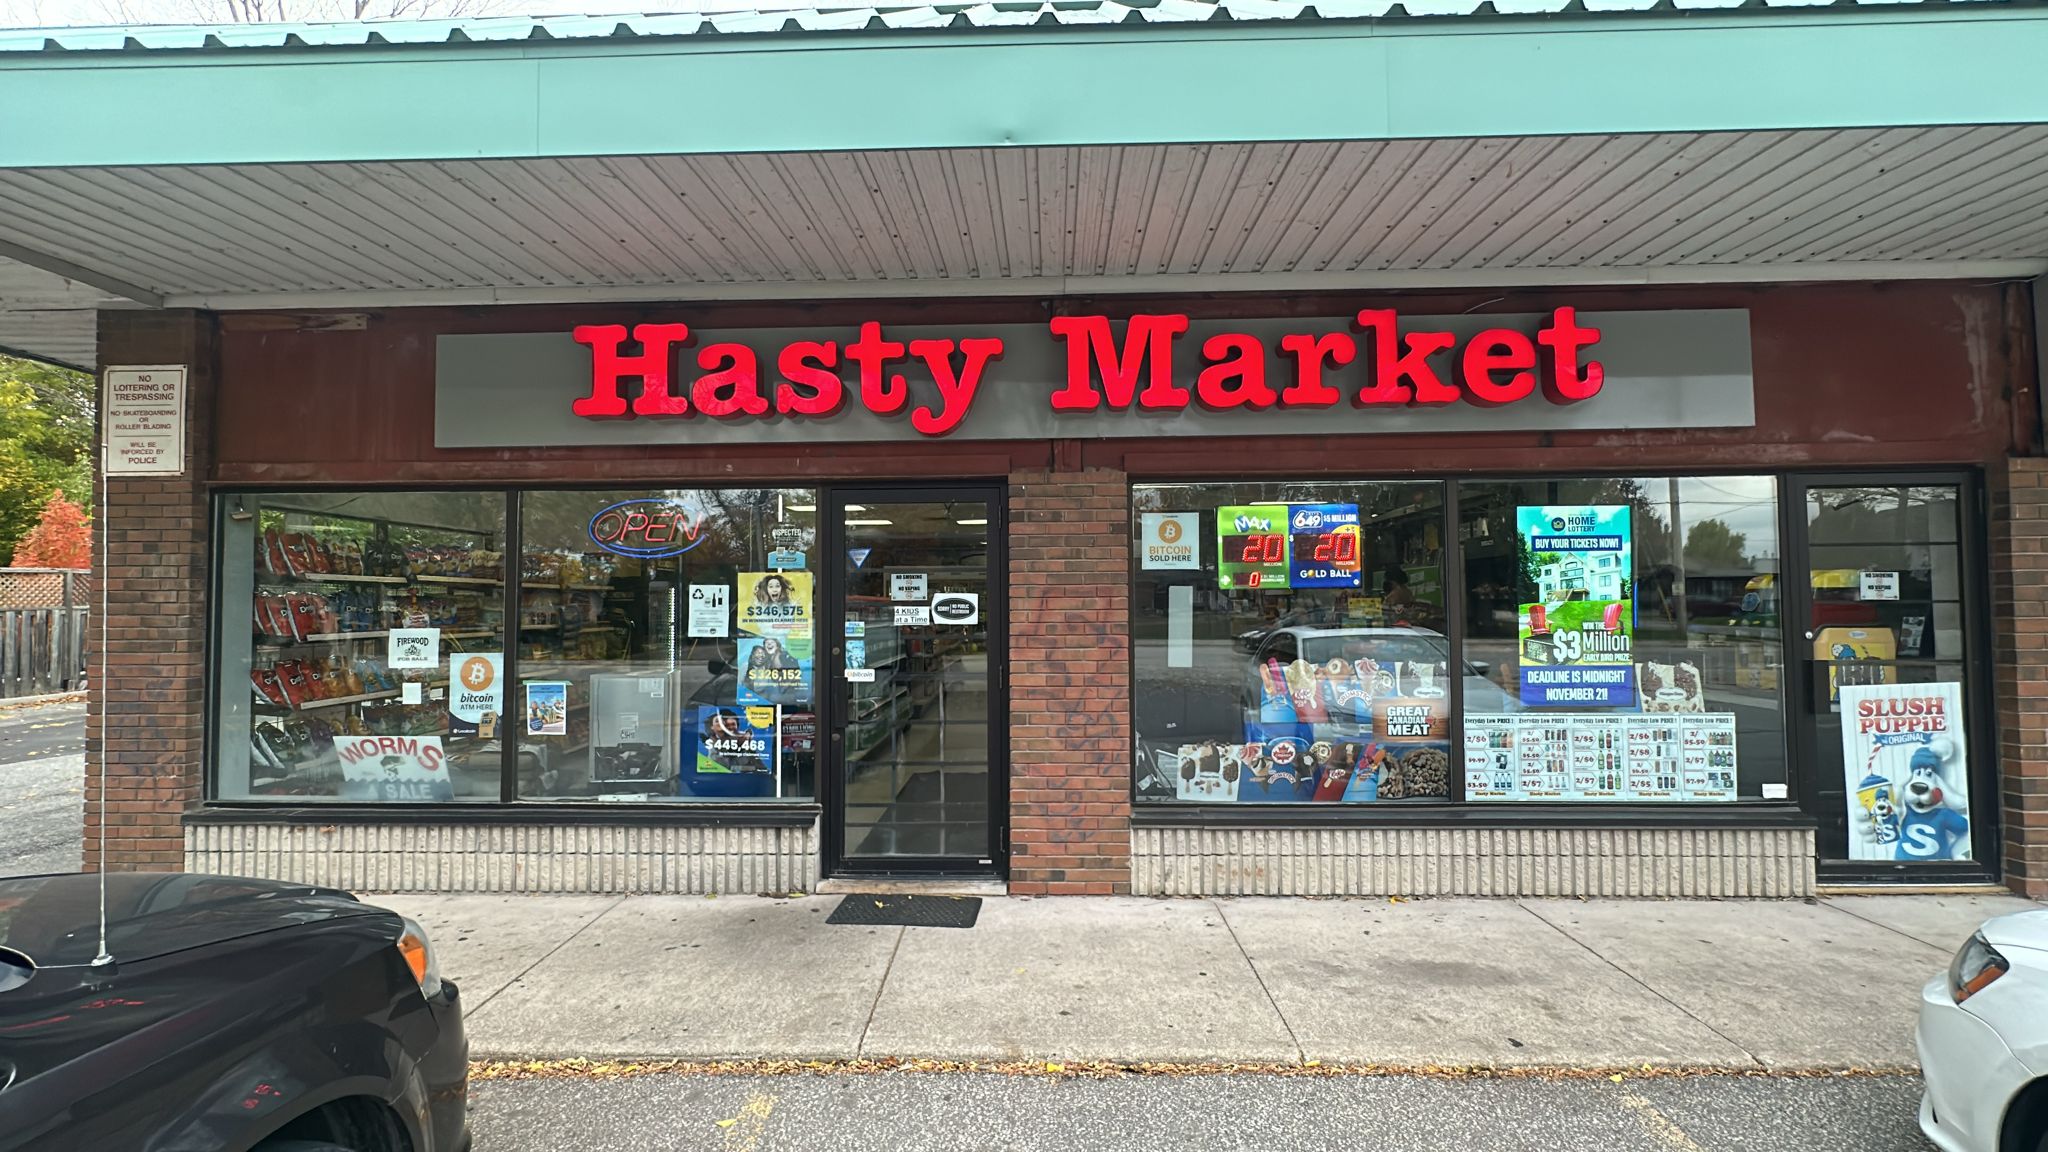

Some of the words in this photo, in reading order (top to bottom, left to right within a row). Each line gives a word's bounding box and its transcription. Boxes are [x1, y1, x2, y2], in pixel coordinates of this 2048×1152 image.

[574, 322, 1003, 436] Hasty
[1050, 306, 1604, 408] Market
[1332, 514, 1357, 522] MILLION
[1568, 517, 1596, 526] HOME
[594, 512, 703, 542] OPEN
[1234, 515, 1272, 532] MAX
[1314, 533, 1356, 562] 20
[1536, 538, 1550, 548] BUY
[1551, 538, 1570, 548] YOUR
[1570, 538, 1598, 548] TICKETS
[1599, 538, 1619, 548] NOW!
[1150, 546, 1192, 554] BITCOIN
[1242, 534, 1285, 563] 20
[1150, 554, 1170, 562] SOLD
[1171, 554, 1192, 562] HERE
[1300, 569, 1326, 578] GOLD
[1330, 569, 1352, 578] BALL
[1248, 571, 1262, 587] 0
[747, 606, 804, 618] $346,575
[1582, 622, 1594, 630] WIN
[1596, 622, 1606, 630] THE
[397, 637, 428, 647] FIREWOOD
[1553, 628, 1581, 662] $3
[1582, 631, 1630, 652] Million
[1584, 654, 1600, 662] EARLY
[1600, 654, 1614, 662] BIRD
[1614, 654, 1631, 662] PRIZE
[748, 669, 802, 681] $326,152
[1528, 672, 1569, 684] DEADLINE
[1572, 672, 1580, 683] IS
[1582, 670, 1626, 683] MIDNIGHT
[460, 693, 494, 703] bitcoin
[1546, 688, 1594, 700] NOVEMBER
[1595, 688, 1608, 700] 21!
[1387, 706, 1431, 717] GREAT
[1858, 698, 1945, 718] SLUSH
[1388, 717, 1426, 725] CANADIAN
[1388, 724, 1431, 736] MEAT
[1690, 730, 1698, 738] 2/
[1630, 732, 1650, 740] 2/$6
[1888, 733, 1926, 744] ORIGINAL
[705, 739, 766, 752] $445,468
[338, 736, 443, 772] WORMS
[1630, 748, 1650, 756] 2/$8
[1686, 758, 1704, 766] 2/$7
[1522, 780, 1542, 788] 2/$7
[1576, 776, 1594, 784] 2/$7
[1630, 780, 1651, 788] 2/$5
[1686, 778, 1705, 786] $7.99
[385, 783, 433, 800] SALE
[1902, 824, 1940, 856] S
